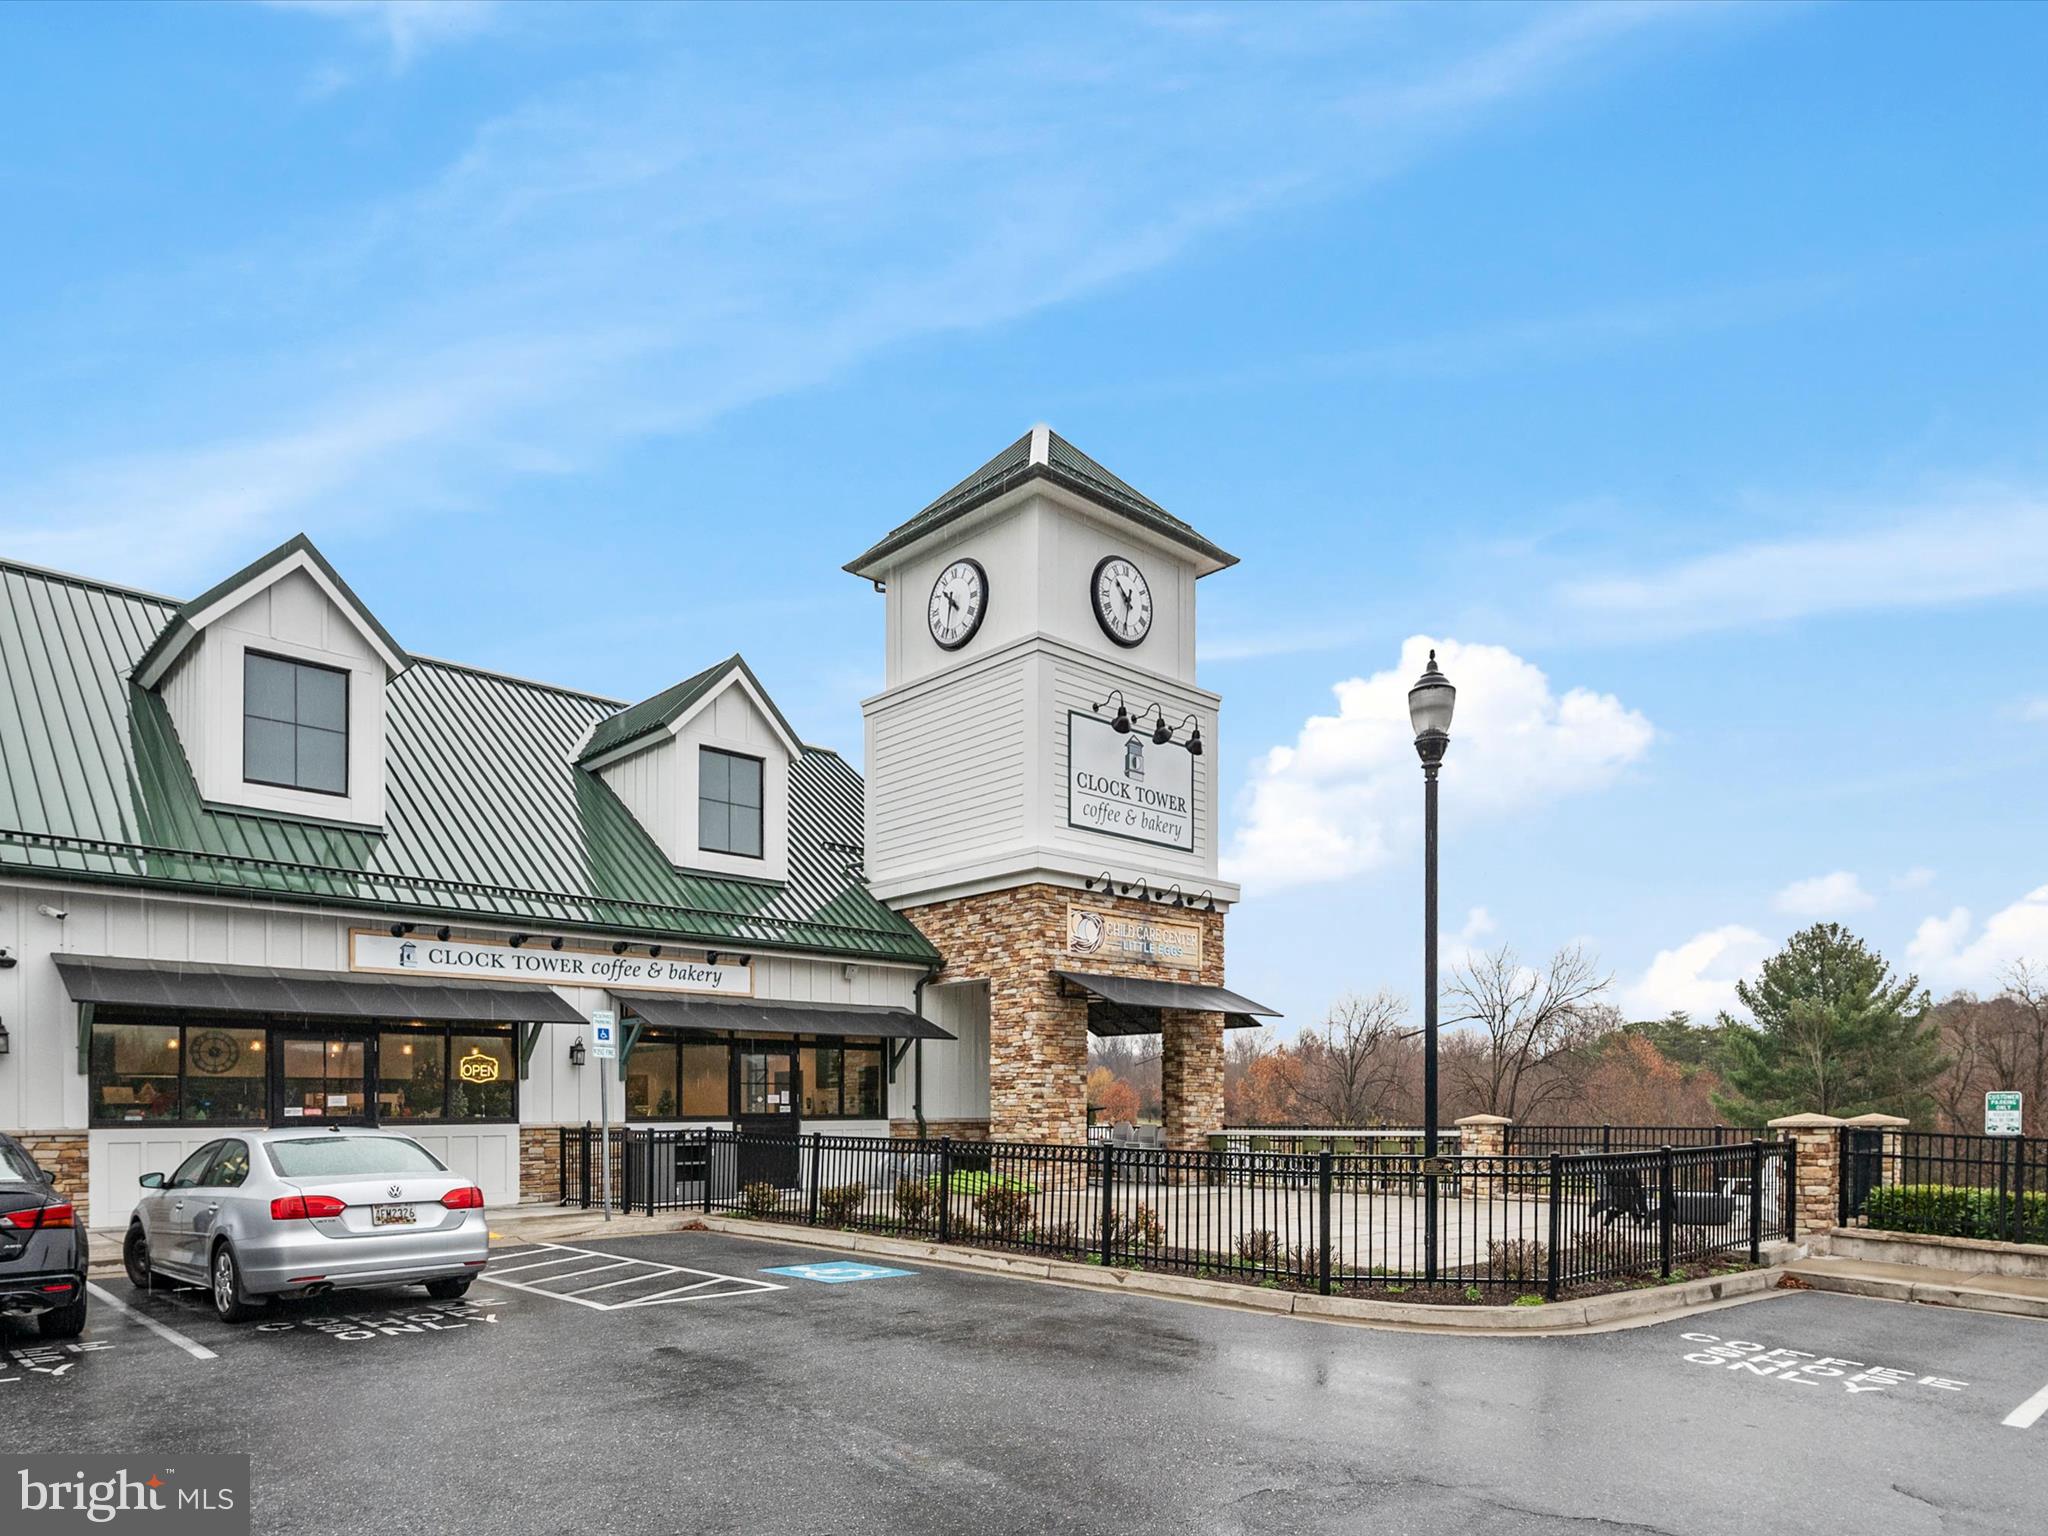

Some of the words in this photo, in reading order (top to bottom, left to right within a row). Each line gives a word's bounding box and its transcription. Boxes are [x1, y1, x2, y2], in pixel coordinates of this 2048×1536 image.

[1077, 772, 1131, 800] CLOCK
[1135, 786, 1187, 813] TOWER
[1083, 802, 1121, 825] coffee
[1125, 809, 1137, 826] &
[1141, 812, 1182, 842] bakery
[1106, 921, 1135, 938] CHILD
[1136, 926, 1161, 942] CARE
[1162, 930, 1198, 947] CENTER
[1121, 940, 1155, 954] LITTLE
[428, 948, 505, 969] CLOCK
[512, 955, 585, 974] TOWER
[591, 959, 641, 982] coffee
[647, 962, 663, 979] &
[668, 963, 722, 988] bakery
[463, 1064, 497, 1077] OPEN
[334, 1314, 498, 1340] ONLY
[1680, 1332, 1970, 1391] COFFEE
[1683, 1353, 1885, 1393] ONLY
